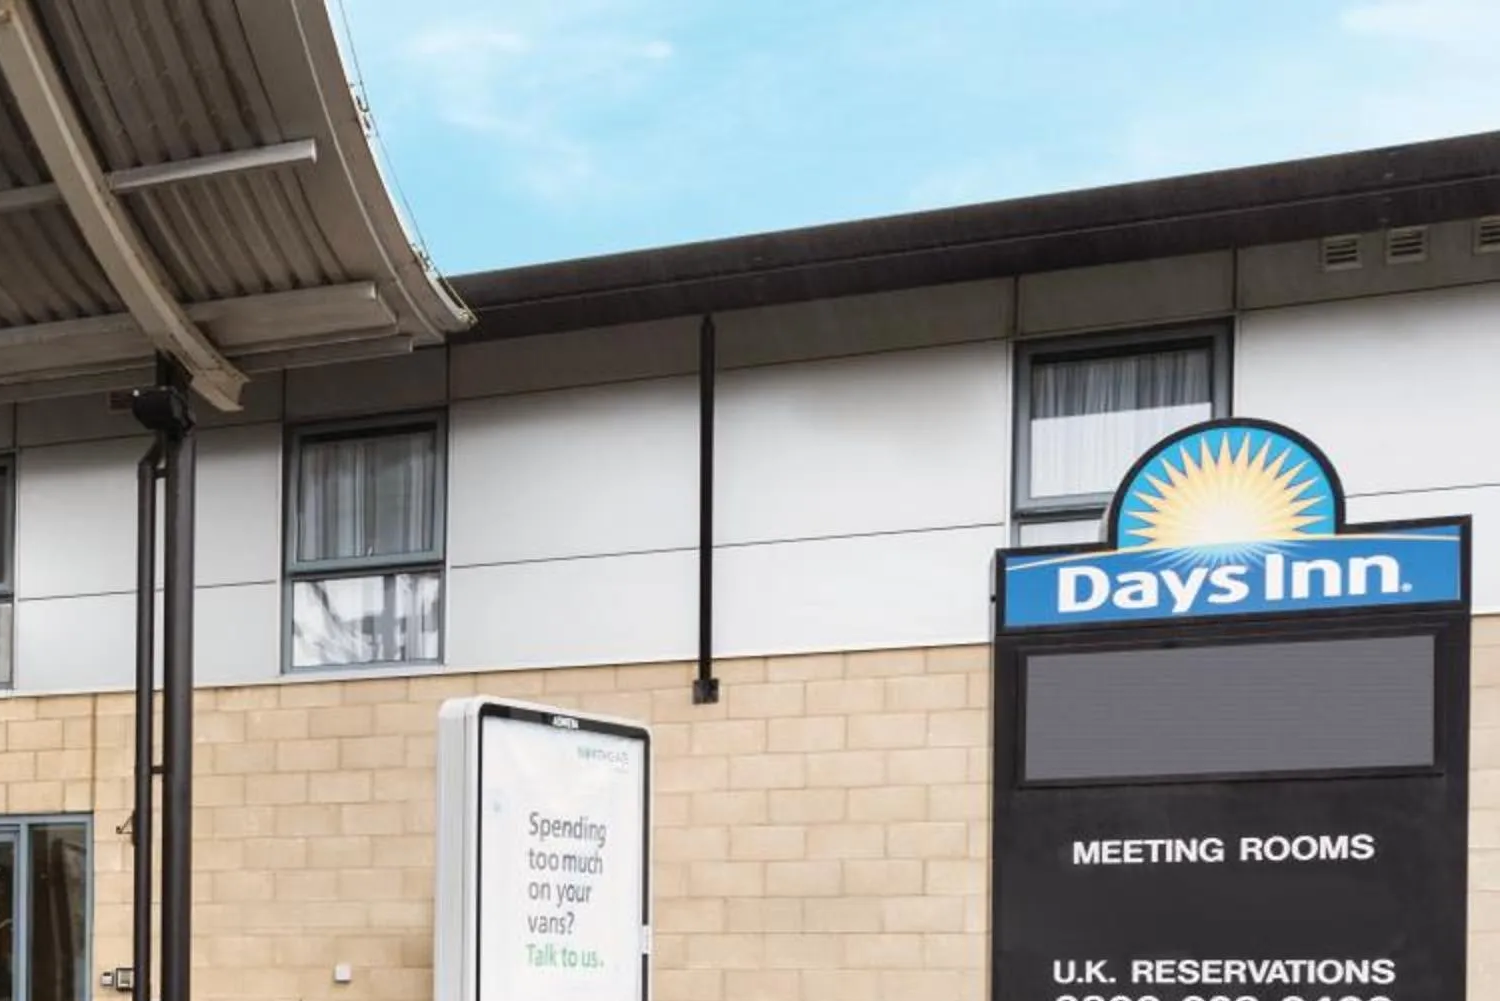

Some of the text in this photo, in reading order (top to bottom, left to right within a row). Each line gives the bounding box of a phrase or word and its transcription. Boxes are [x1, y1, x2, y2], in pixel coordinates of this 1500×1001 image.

[1057, 562, 1250, 613] Days
[528, 811, 606, 848] Spending
[528, 848, 603, 875] too much
[1072, 833, 1376, 866] MEETING ROOMS
[528, 881, 592, 908] on your
[527, 910, 575, 935] vans?
[525, 943, 557, 968] Talk
[562, 947, 578, 968] to
[1052, 957, 1397, 986] U.K. RESERVATIONS
